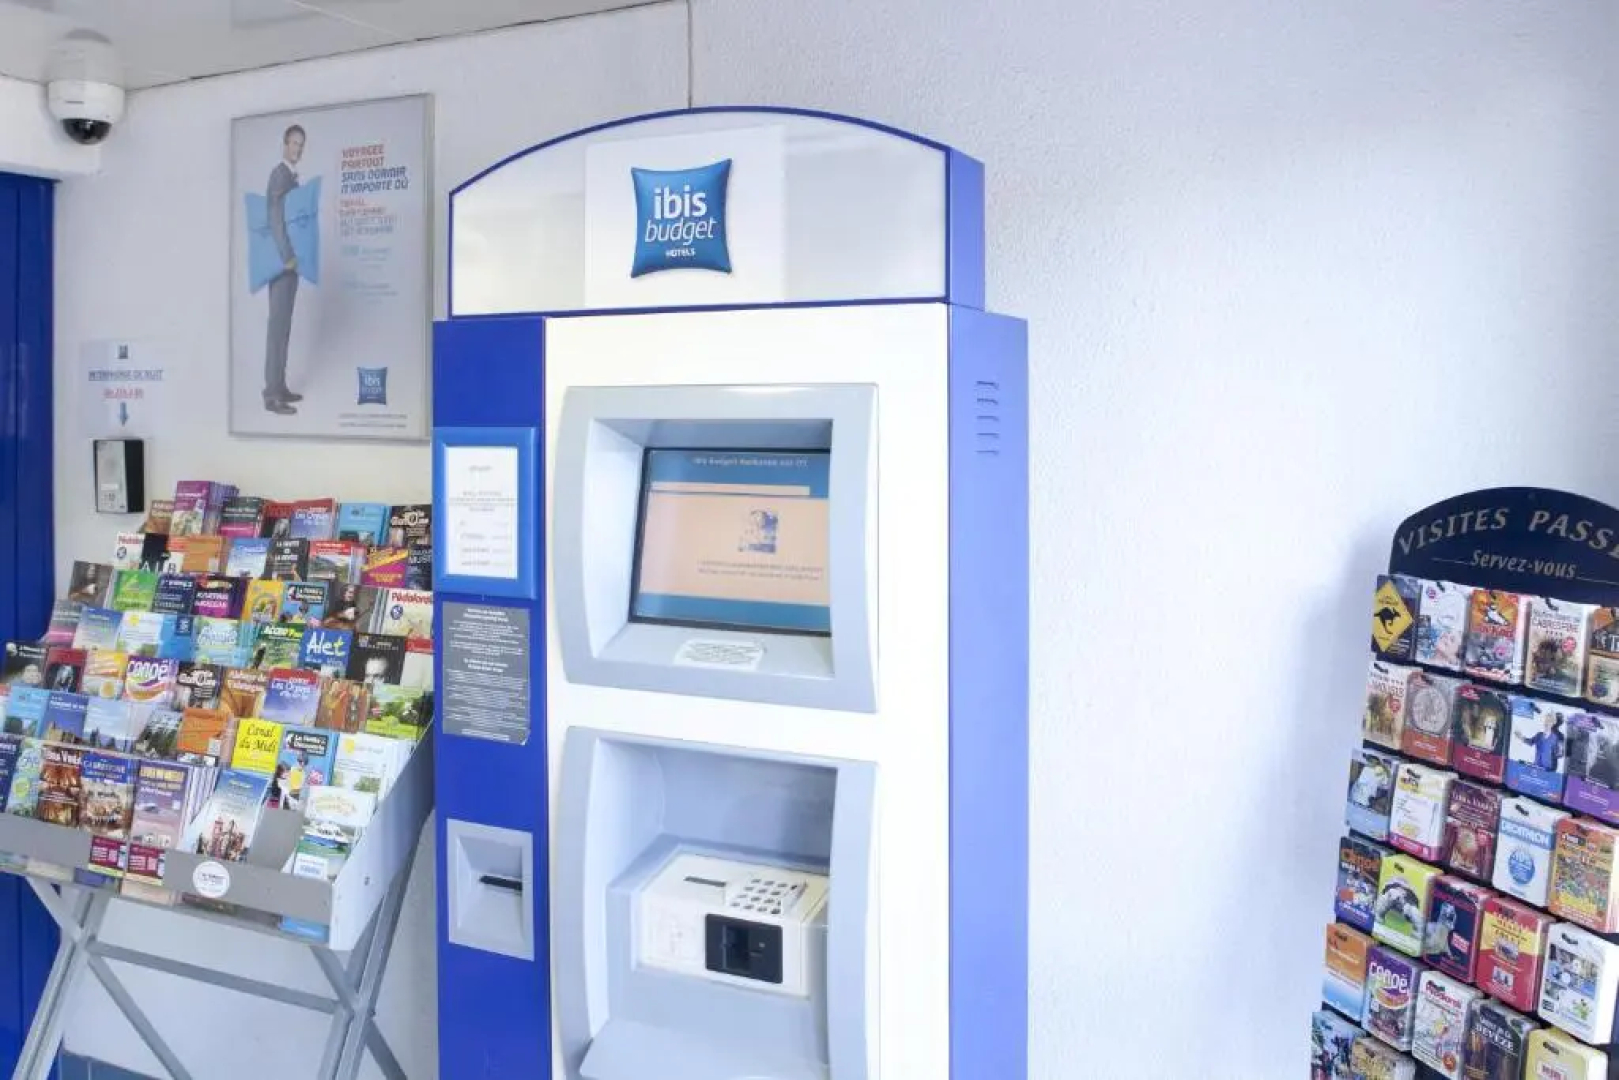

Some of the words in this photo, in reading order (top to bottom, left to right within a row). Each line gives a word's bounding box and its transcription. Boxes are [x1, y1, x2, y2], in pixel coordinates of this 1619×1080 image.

[341, 156, 385, 171] PARTOUT
[341, 170, 366, 183] SANS
[367, 166, 407, 180] DORMIR
[654, 184, 707, 220] ibis
[645, 216, 718, 245] budget
[665, 247, 696, 257] HOTELS
[1399, 508, 1510, 555] VISITES
[1470, 550, 1577, 579] Servez-vous
[307, 630, 346, 656] Alet
[247, 723, 274, 738] Canal
[253, 738, 277, 754] Midi
